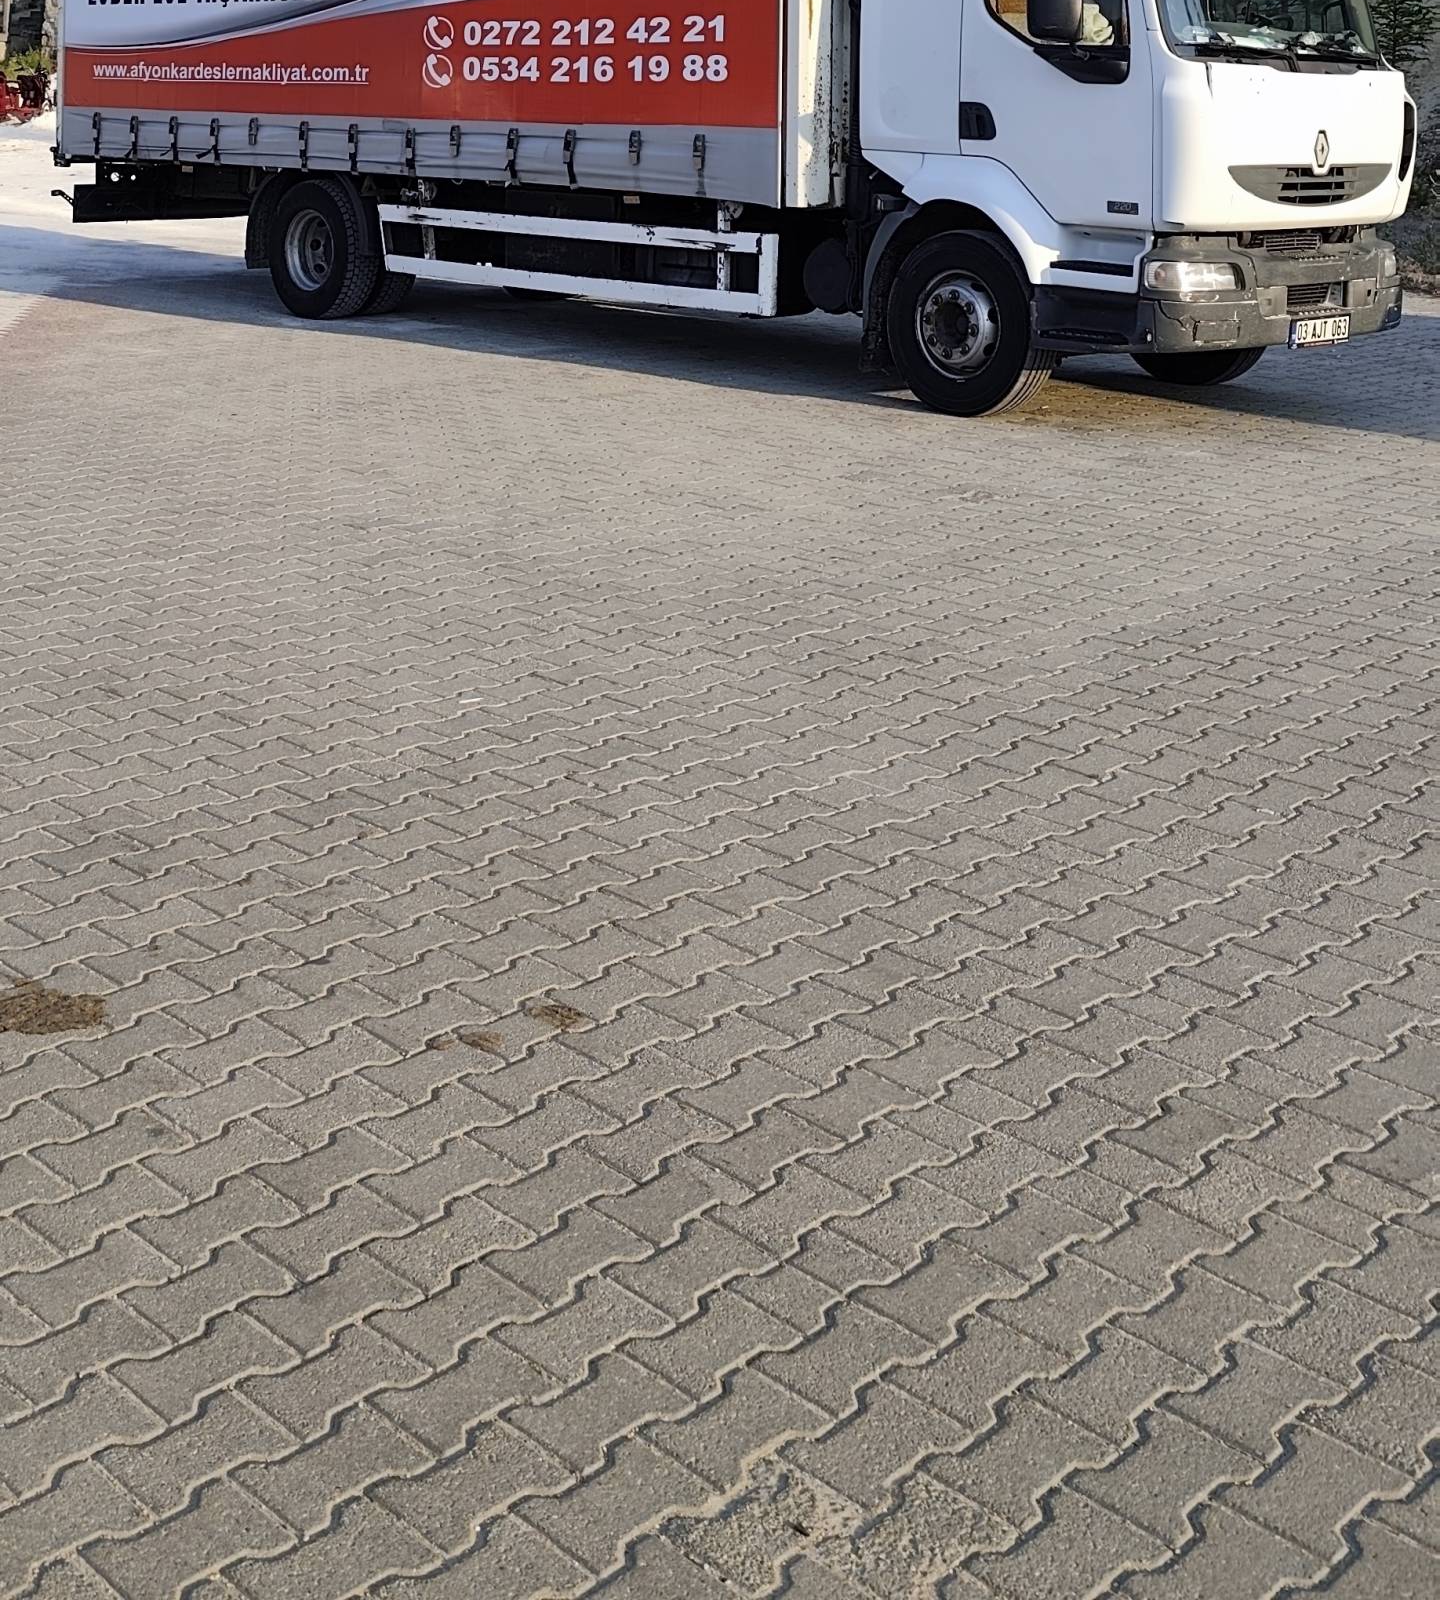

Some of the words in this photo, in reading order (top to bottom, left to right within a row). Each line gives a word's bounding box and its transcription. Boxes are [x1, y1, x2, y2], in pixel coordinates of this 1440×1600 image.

[462, 20, 541, 46] 0272
[551, 18, 615, 46] 212
[626, 16, 670, 44] 42
[682, 14, 726, 43] 21
[93, 60, 369, 85] www.afyonkardeslernakliyat.com.tr
[462, 56, 540, 82] 0534
[550, 56, 614, 82] 216
[627, 55, 670, 82] 19
[682, 54, 728, 82] 88
[1297, 323, 1308, 341] 03
[1311, 320, 1328, 340] AJT
[1331, 318, 1347, 337] 063
